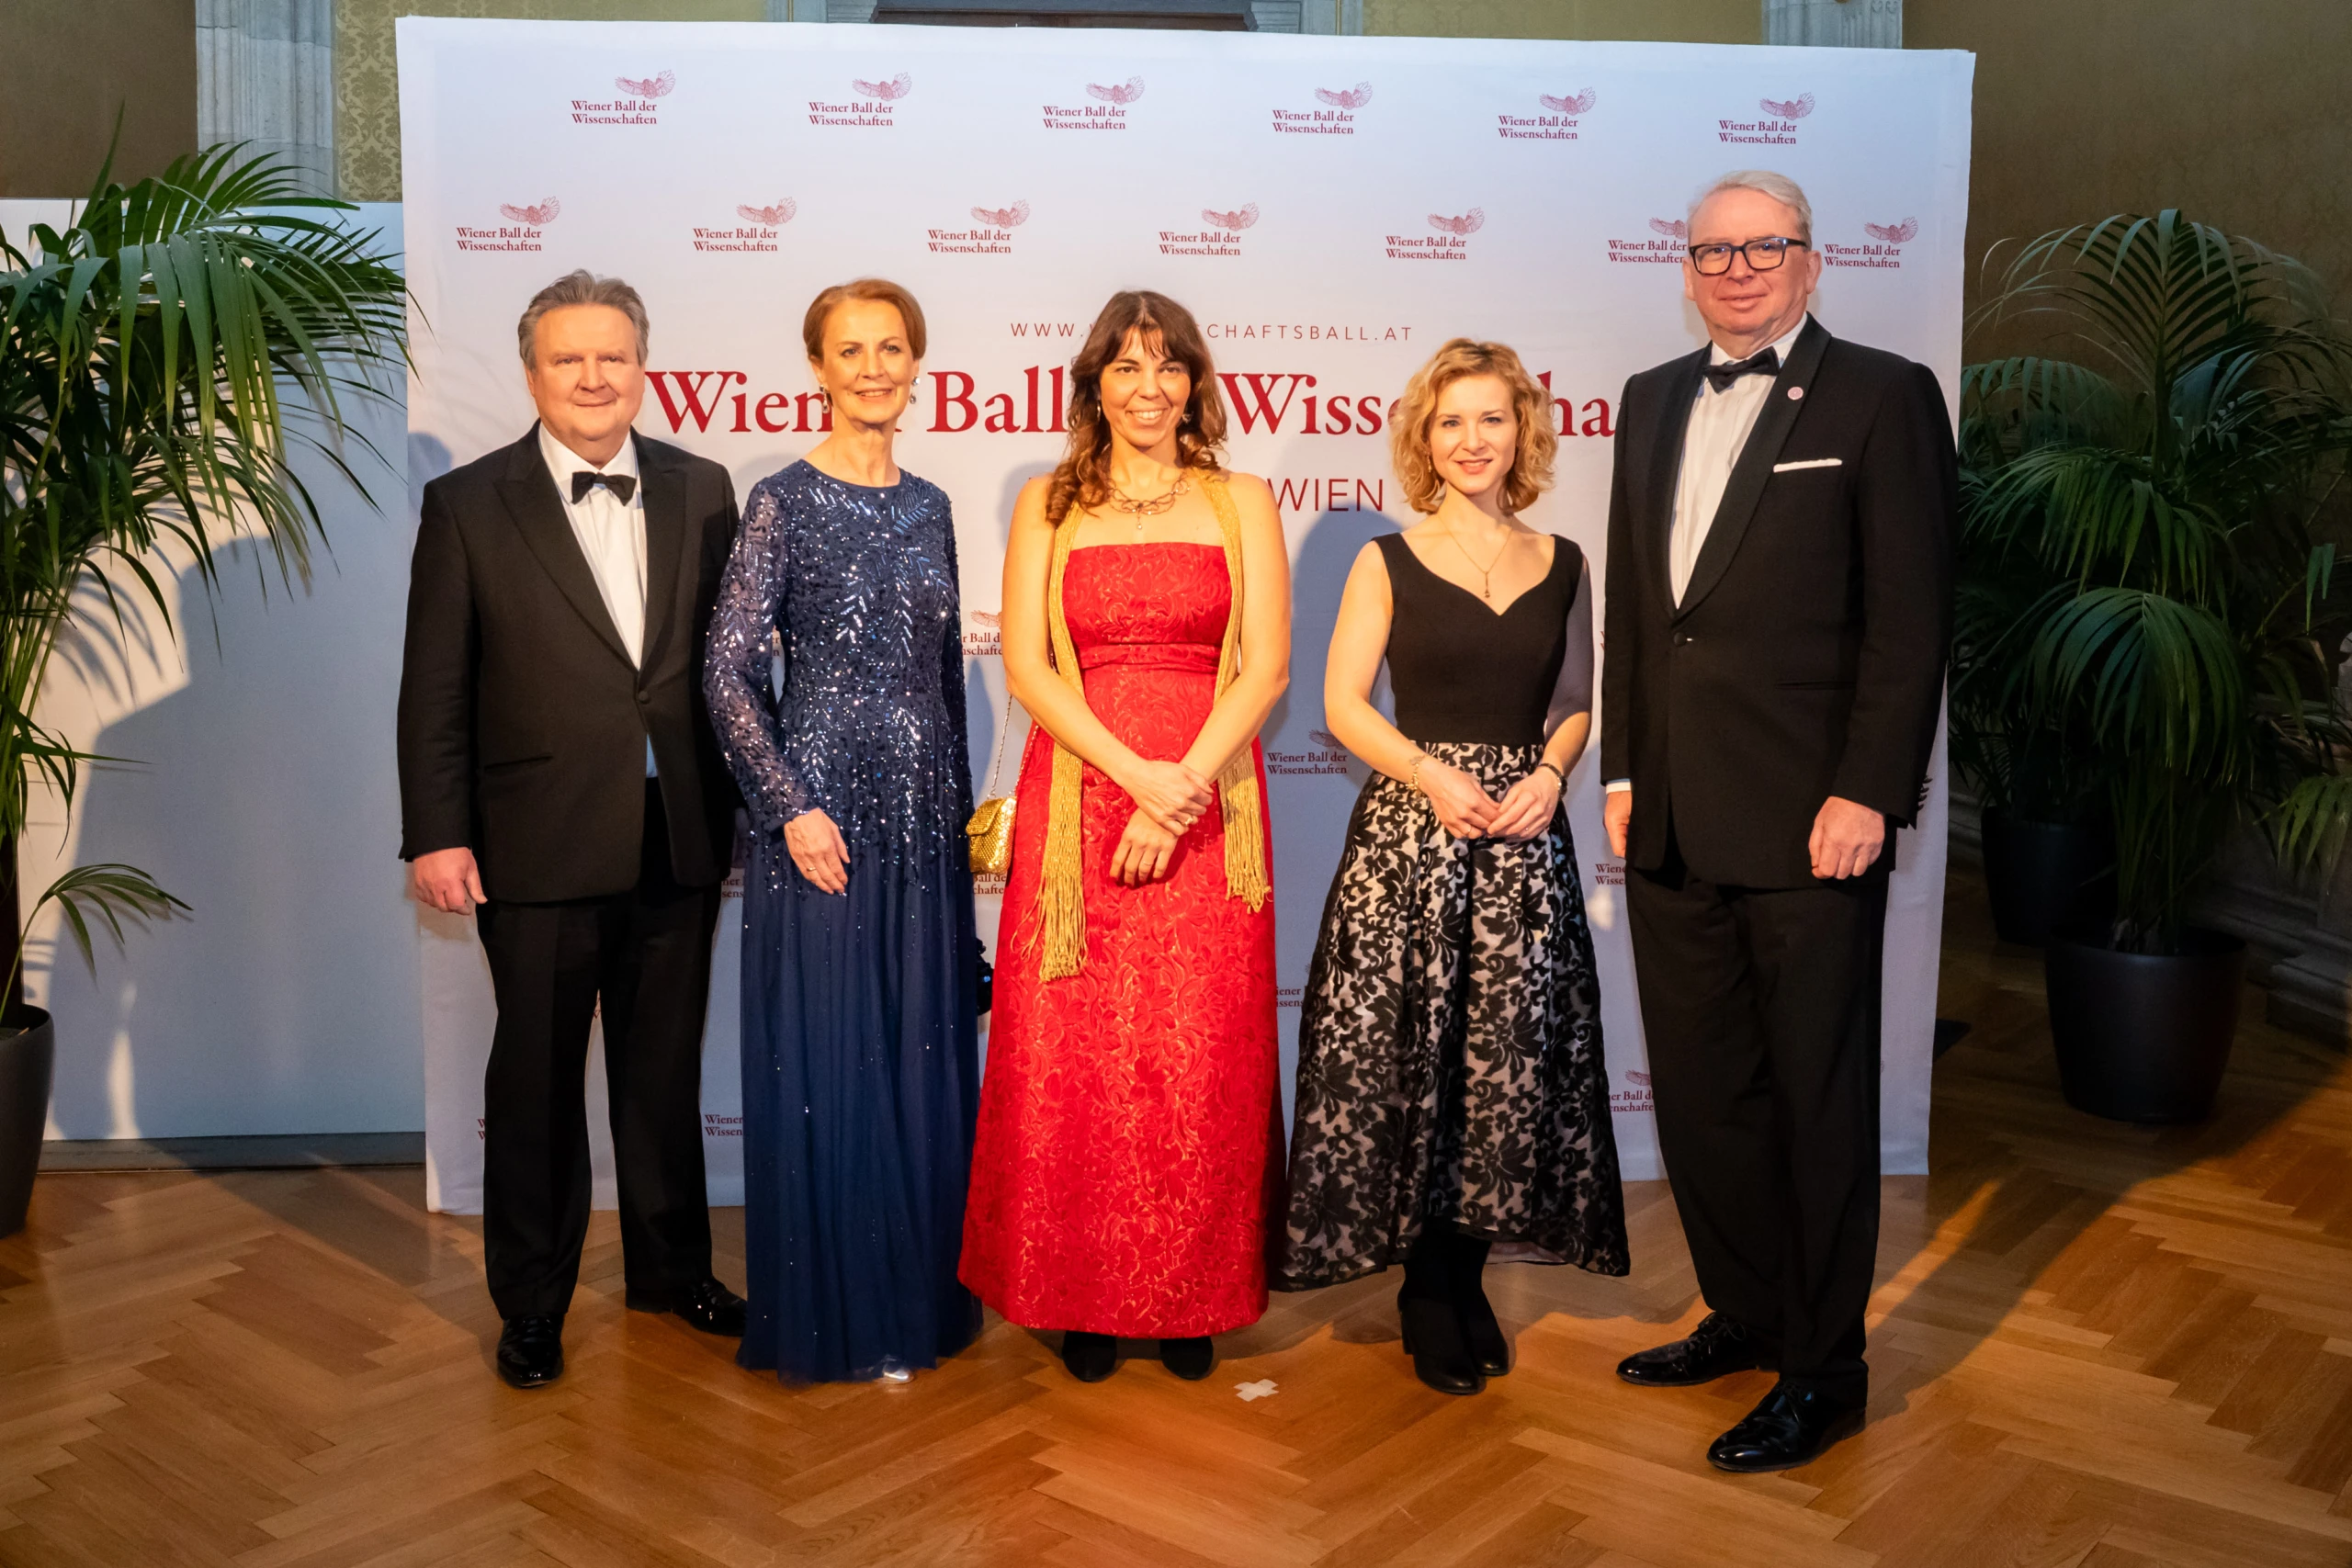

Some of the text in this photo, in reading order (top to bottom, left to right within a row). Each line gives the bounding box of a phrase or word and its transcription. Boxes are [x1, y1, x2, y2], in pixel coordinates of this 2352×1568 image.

[571, 101, 657, 111] Wiener Ball der
[809, 102, 893, 113] Wiener Ball der
[1043, 106, 1126, 117] Wiener Ball der
[571, 113, 657, 124] Wissenschaften
[809, 115, 893, 126] Wissenschaften
[1272, 110, 1354, 121] Wiener Ball der
[1043, 118, 1126, 130] Wissenschaften
[1498, 116, 1578, 127] Wiener Ball der
[1719, 120, 1798, 131] Wiener Ball der
[1272, 122, 1354, 134] Wissenschaften
[1498, 128, 1578, 140] Wissenschaften
[1719, 132, 1798, 144] Wissenschaften
[457, 228, 542, 238] Wiener Ball der
[693, 228, 778, 238] Wiener Ball der
[928, 230, 1012, 241] Wiener Ball der
[1159, 231, 1241, 243] Wiener Ball der
[457, 241, 542, 251] Wissenschaften
[693, 241, 778, 252] Wissenschaften
[1385, 236, 1467, 247] Wiener Ball der
[1608, 240, 1687, 251] Wiener Ball der
[928, 243, 1012, 253] Wissenschaften
[1159, 244, 1241, 255] Wissenschaften
[1825, 244, 1901, 256] Wiener Ball der
[1385, 249, 1467, 260] Wissenschaften
[1825, 256, 1901, 268] Wissenschaften
[644, 371, 902, 434] Wien
[927, 366, 1069, 434] Ball
[1267, 478, 1383, 512] WIEN
[970, 632, 990, 643] Ball
[1268, 751, 1348, 762] Wiener Ball der
[1268, 764, 1348, 775] Wissenschaften
[1623, 1090, 1643, 1101] Ball
